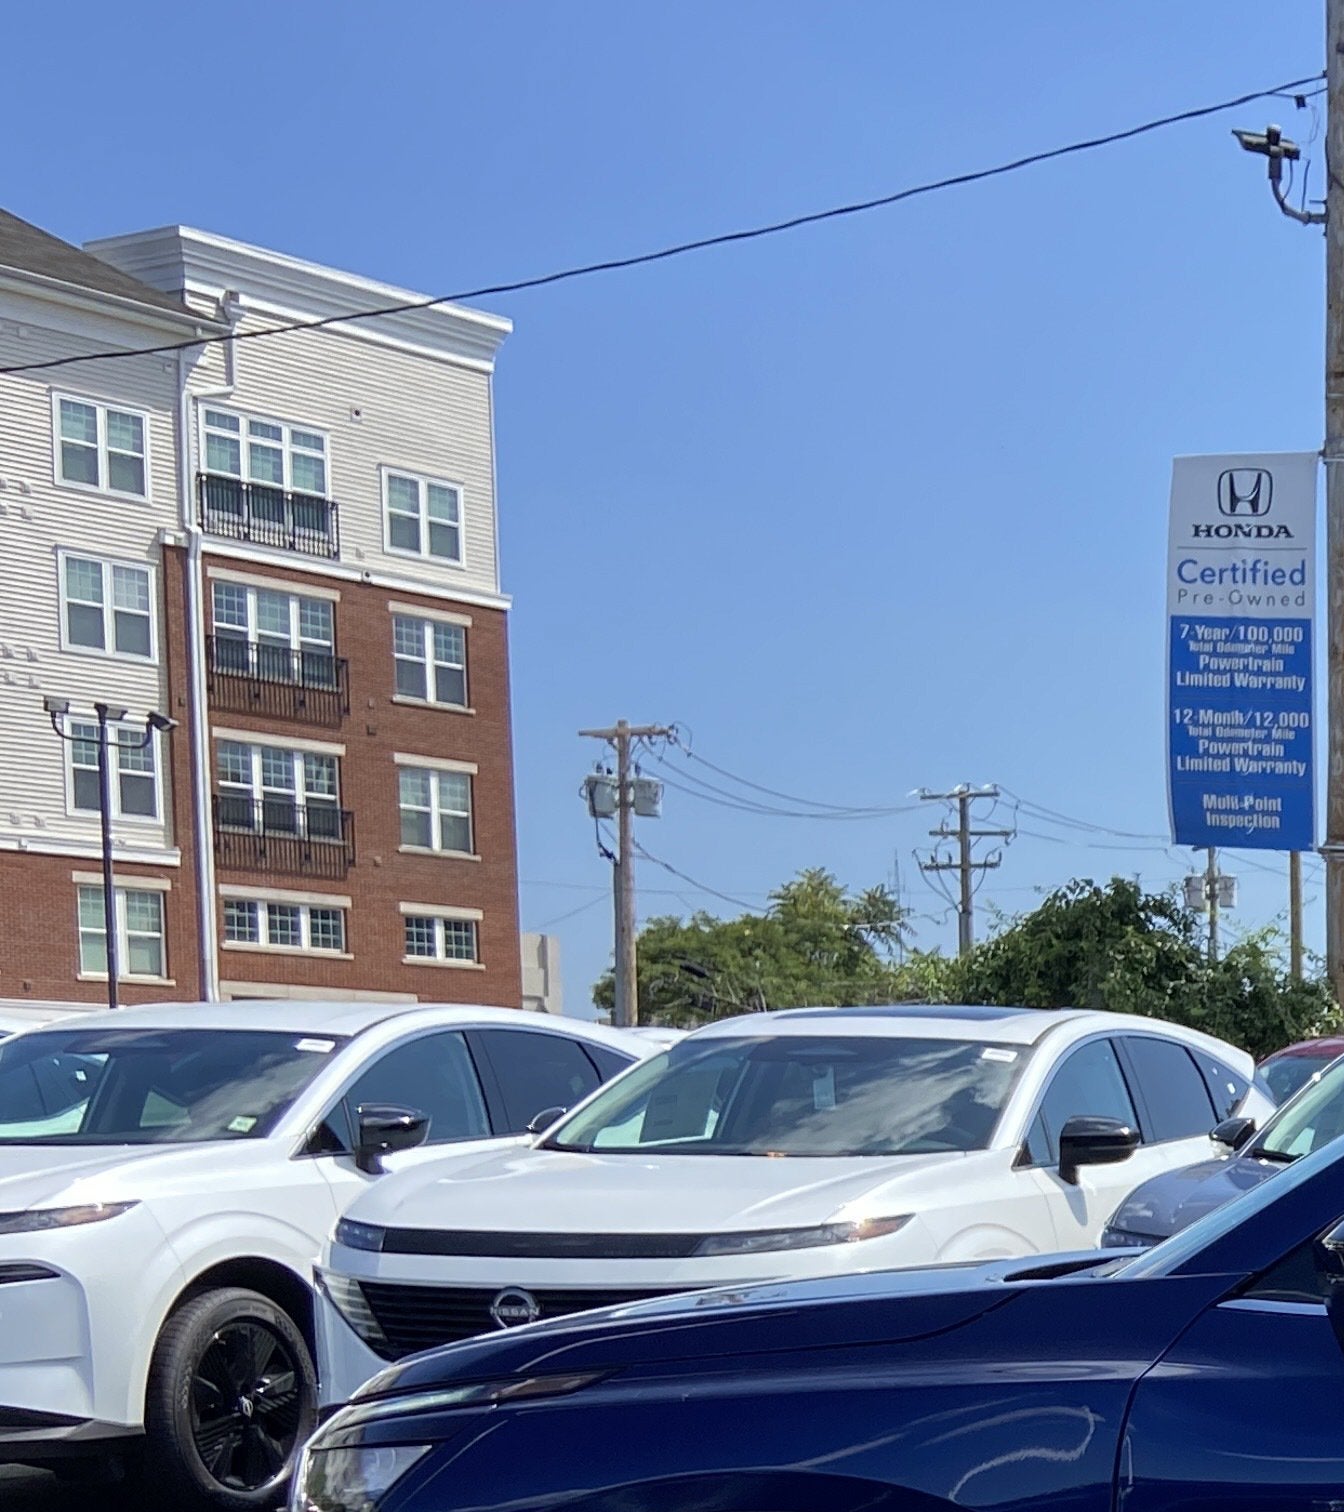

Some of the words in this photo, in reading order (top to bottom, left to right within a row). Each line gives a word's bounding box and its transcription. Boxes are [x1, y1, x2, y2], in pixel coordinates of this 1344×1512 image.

[1191, 523, 1294, 539] HONDA
[1177, 559, 1307, 586] Certified
[1177, 590, 1306, 608] Pre-Owned
[1180, 624, 1304, 643] 7-Year/100,000
[1199, 655, 1285, 672] Powertrain
[1176, 671, 1231, 688] Limited
[1234, 672, 1306, 692] Warranty
[1174, 708, 1310, 729] 12-Month/12,000
[1198, 739, 1285, 757] Powertrain
[1176, 755, 1231, 772] Limited
[1234, 757, 1307, 777] Warranty
[1206, 811, 1280, 829] Inspection
[490, 1306, 540, 1317] NISSAN
